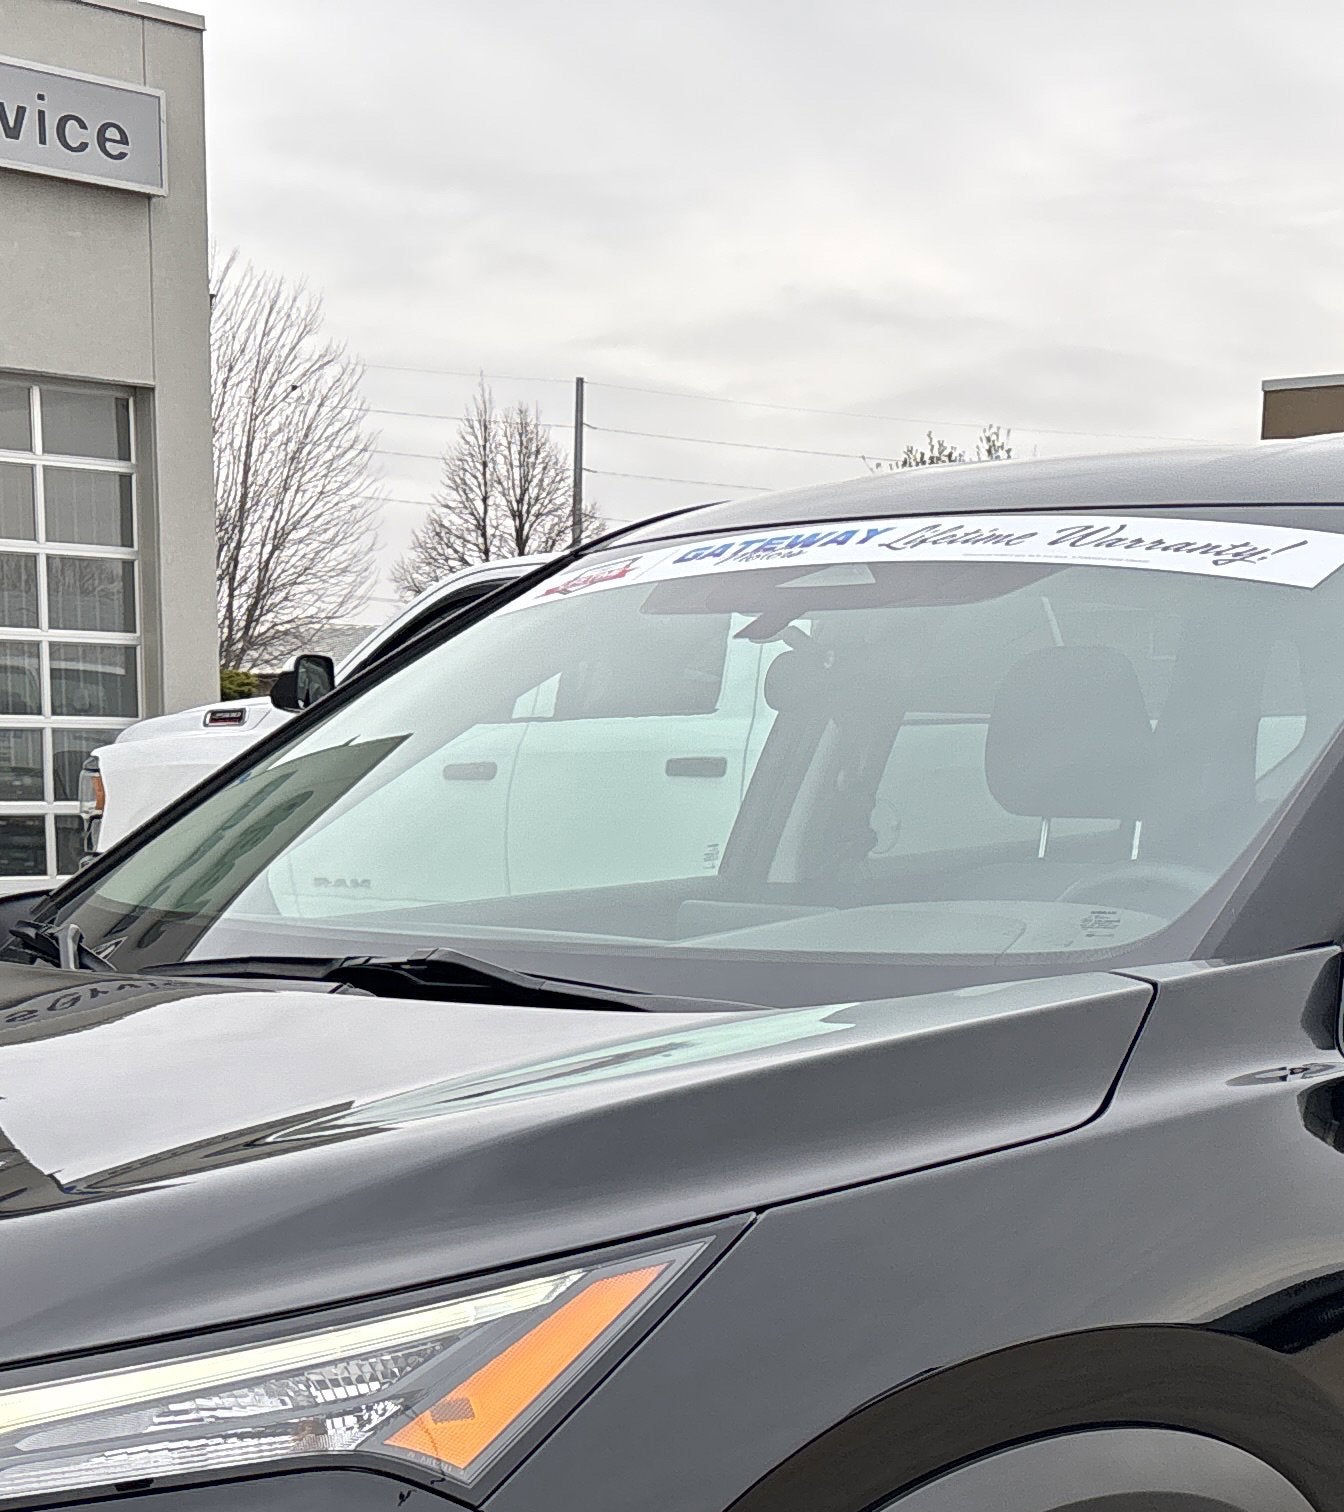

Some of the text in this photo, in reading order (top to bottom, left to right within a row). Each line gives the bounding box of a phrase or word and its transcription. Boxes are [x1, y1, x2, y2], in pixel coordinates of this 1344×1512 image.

[672, 523, 1308, 566] GATEWAY Lifetime Warranty!
